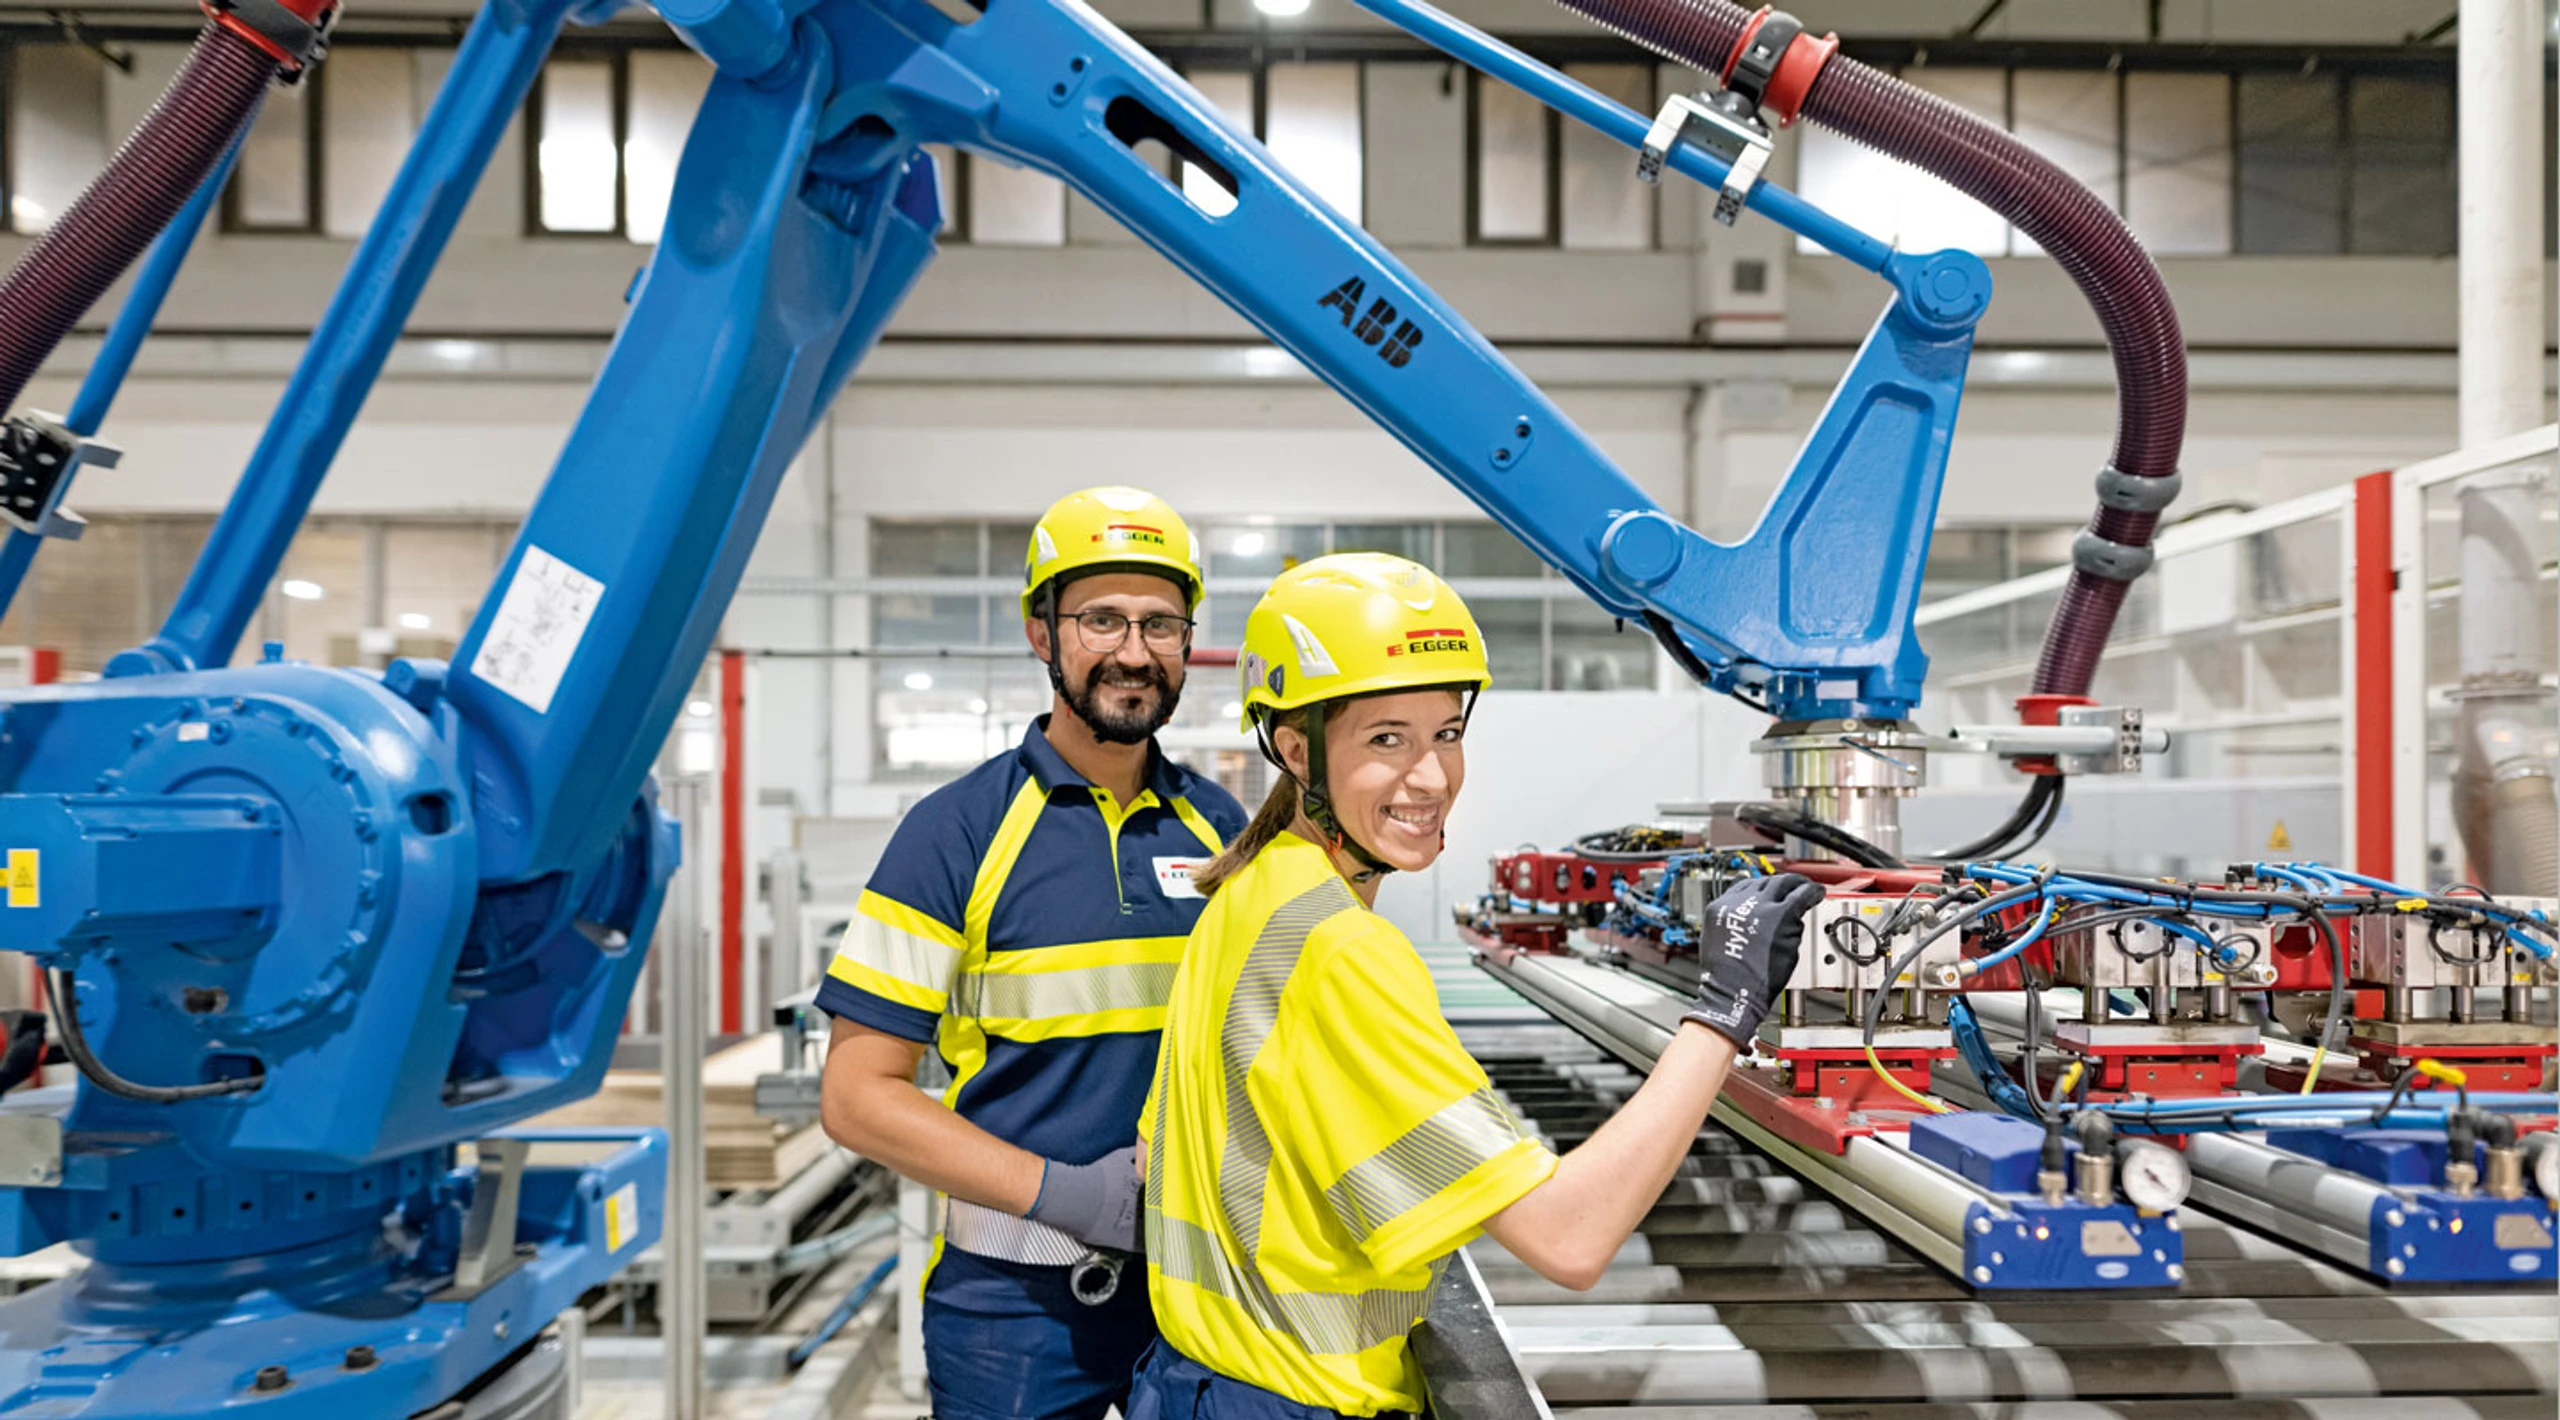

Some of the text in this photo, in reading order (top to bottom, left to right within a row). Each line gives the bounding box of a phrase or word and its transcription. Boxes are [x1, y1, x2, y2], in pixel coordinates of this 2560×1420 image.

[1317, 276, 1424, 369] ABB
[1409, 640, 1469, 654] EGGER
[1724, 896, 1758, 960] HyFlex
